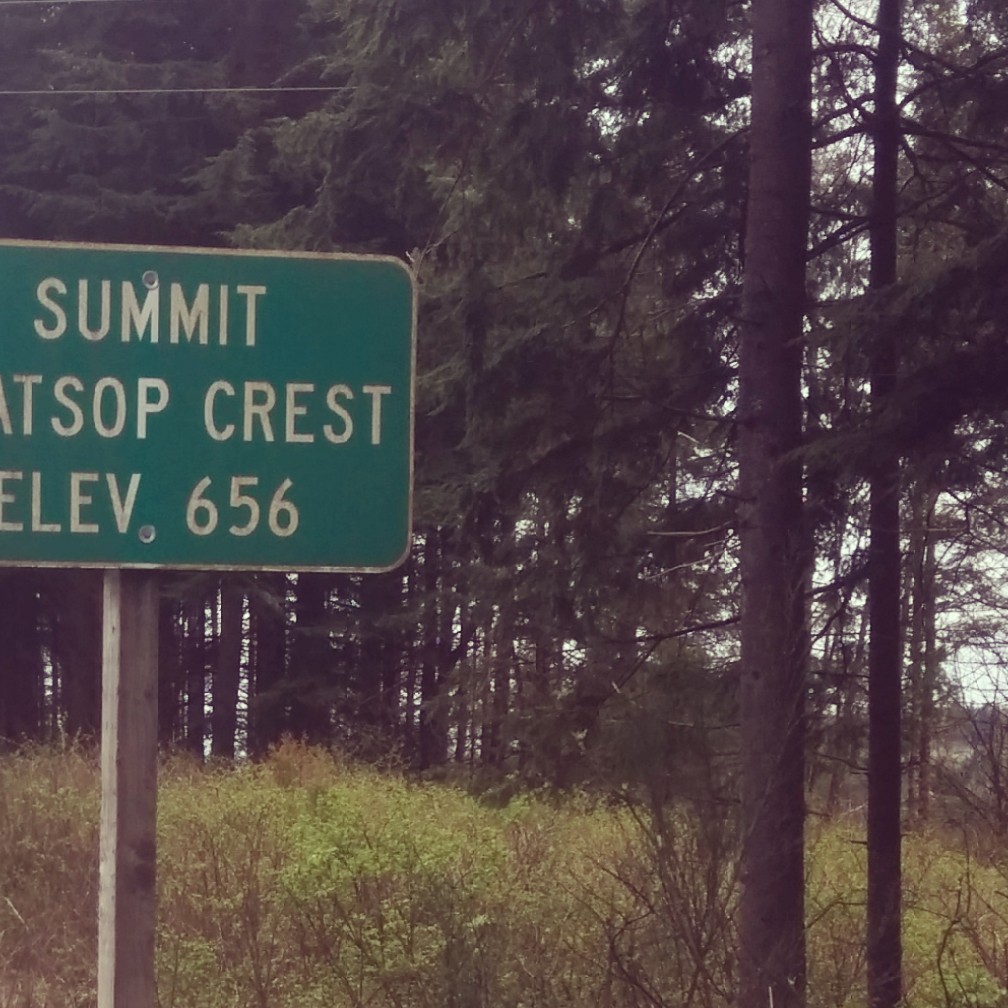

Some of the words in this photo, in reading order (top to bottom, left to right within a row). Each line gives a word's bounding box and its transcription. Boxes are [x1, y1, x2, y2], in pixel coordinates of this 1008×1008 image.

[33, 277, 267, 346] SUMMIT
[204, 380, 391, 445] CREST
[186, 476, 299, 537] 656
